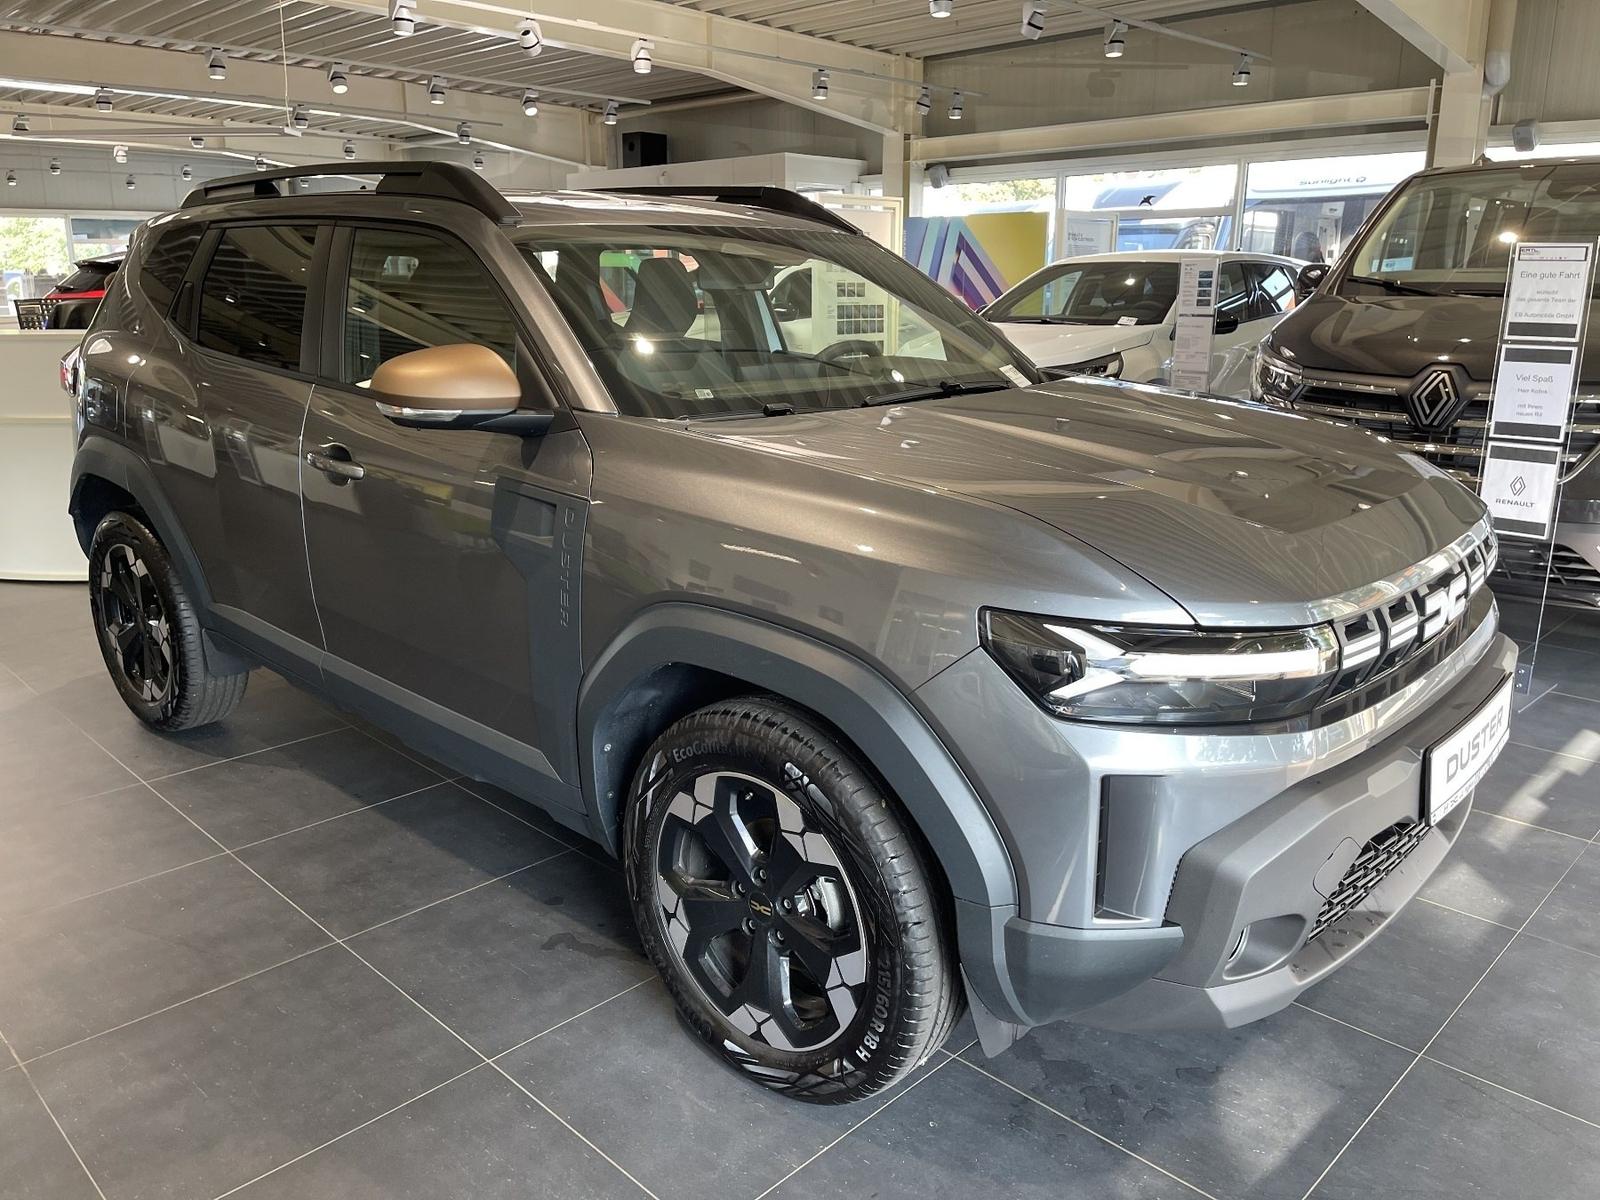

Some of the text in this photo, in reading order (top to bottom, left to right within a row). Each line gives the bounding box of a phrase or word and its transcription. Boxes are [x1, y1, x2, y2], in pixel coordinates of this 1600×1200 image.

[1520, 270, 1581, 280] Eine gute Fahrt
[1531, 374, 1554, 383] Spaß
[1495, 498, 1536, 508] RENAULT
[560, 507, 575, 628] DUSTER
[1446, 705, 1504, 784] DUSTER
